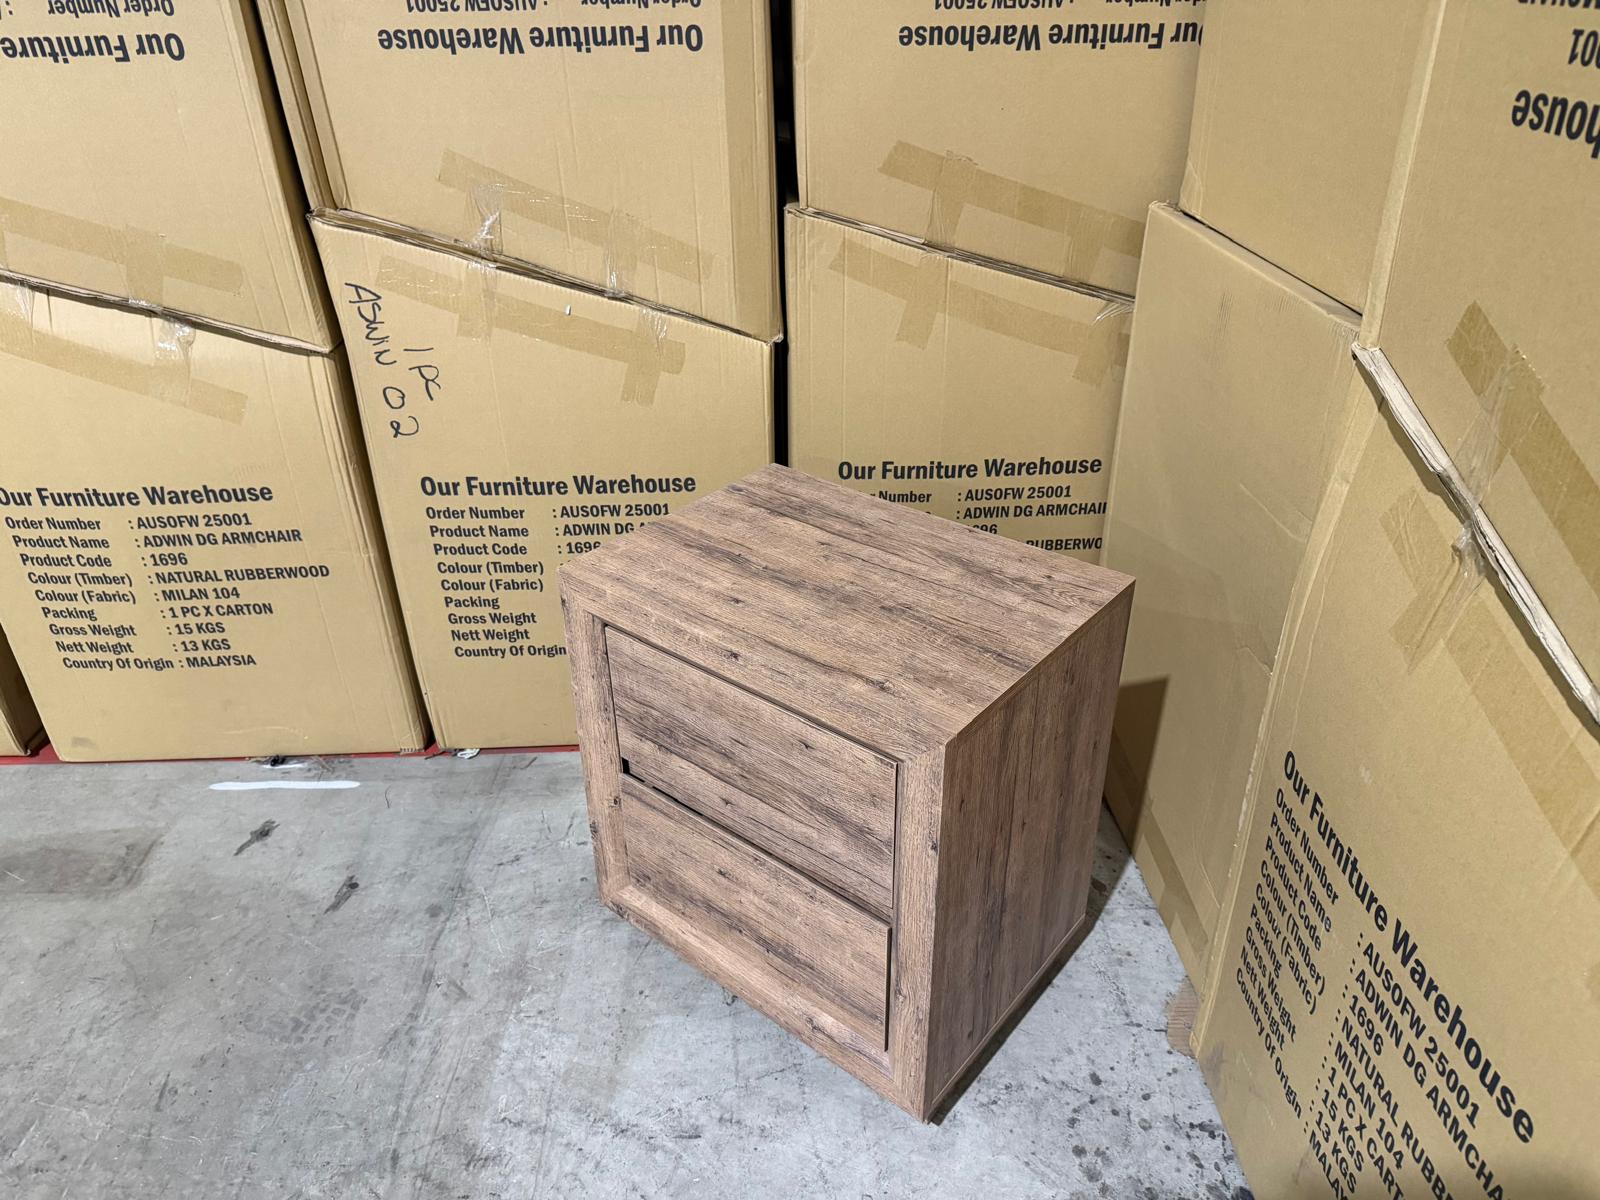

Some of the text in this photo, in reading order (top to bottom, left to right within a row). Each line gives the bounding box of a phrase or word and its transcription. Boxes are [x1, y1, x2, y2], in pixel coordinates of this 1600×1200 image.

[48, 0, 120, 18] Number
[124, 0, 174, 16] Order
[378, 24, 703, 55] Our Furniture Warehouse
[899, 22, 1203, 51] ur Furniture Warehouse
[0, 33, 185, 64] Our Furniture
[838, 457, 1102, 480] Our Furniture Warehouse
[420, 474, 696, 496] Our Furniture Warehouse
[878, 490, 932, 503] Number
[965, 487, 1024, 501] AUSOFW
[1027, 485, 1071, 499] 25001
[35, 487, 140, 507] Furniture
[142, 484, 273, 506] Warehouse
[425, 506, 466, 519] Order
[468, 506, 525, 519] Number
[560, 504, 621, 518] AUSOFW
[624, 503, 670, 517] 25001
[963, 506, 1009, 519] ADWIN
[1014, 505, 1033, 517] DG
[5, 516, 43, 530] Order
[45, 517, 101, 530] Number
[137, 515, 199, 530] AUSOFW
[202, 513, 252, 527] 25001
[429, 525, 486, 538] Product
[488, 525, 529, 537] Name
[563, 523, 611, 536] ADWIN
[12, 535, 68, 548] Product
[68, 536, 110, 549] Name
[144, 534, 194, 548] ADWIN
[195, 533, 219, 546] DG
[222, 529, 303, 545] ARMCHAIR
[433, 543, 489, 555] Product
[491, 543, 527, 555] Code
[19, 553, 75, 567] Product
[76, 554, 112, 567] Code
[150, 552, 188, 566] 1696
[437, 561, 483, 574] Colour
[486, 561, 544, 576] (Timber)
[27, 572, 72, 585] Colour
[74, 572, 133, 588] (Timber)
[155, 570, 223, 584] NATURAL
[224, 565, 330, 582] RUBBERWOOD
[440, 578, 544, 593] Colour (Fabric)
[34, 589, 78, 602] Colour
[81, 590, 136, 605] (Fabric)
[161, 588, 209, 601] MILAN
[212, 587, 240, 599] 104
[444, 596, 500, 610] Packing
[41, 606, 98, 622] Packing
[168, 607, 179, 618] 1
[180, 605, 201, 618] PC
[202, 605, 214, 617] X
[215, 603, 274, 616] CARTON
[448, 612, 537, 626] Gross Weight
[49, 623, 88, 636] Gross
[87, 624, 137, 638] Weight
[175, 623, 194, 635] 15
[195, 622, 226, 634] KGS
[451, 628, 530, 643] Nett Weight
[55, 641, 86, 653] Nett
[85, 641, 134, 655] Weight
[180, 640, 199, 652] 13
[201, 638, 231, 651] KGS
[454, 644, 567, 659] Country Of Origin
[62, 657, 113, 671] Country
[115, 658, 131, 669] Of
[133, 658, 174, 671] Origin
[185, 654, 257, 668] MALAYSIA
[1265, 835, 1298, 907] Product
[1298, 899, 1321, 952] Code
[1349, 995, 1384, 1056] 1696
[1270, 811, 1304, 883] Product
[1303, 872, 1332, 933] Name
[1355, 969, 1403, 1049] ADWIN
[1402, 1042, 1427, 1088] DG
[1284, 750, 1534, 1143] Our Furniture Warehouse
[1276, 788, 1301, 838] Order
[1300, 830, 1339, 905] Number
[1362, 942, 1427, 1040] AUSOFW
[1424, 1036, 1479, 1129] 25001
[1250, 903, 1282, 979] Packing
[1328, 1066, 1337, 1088] 1
[1337, 1082, 1356, 1119] PC
[1354, 1114, 1367, 1141] X
[1256, 883, 1282, 940] Colour
[1280, 936, 1317, 1015] (Fabric)
[1334, 1040, 1376, 1120] MILAN
[1376, 1117, 1404, 1170] 104
[1261, 860, 1287, 917] Colour
[1286, 913, 1325, 996] (Timber)
[1341, 1016, 1399, 1128] NATURAL
[1400, 1120, 1454, 1200] RUBB
[1236, 968, 1265, 1037] Country
[1265, 1032, 1276, 1059] Of
[1275, 1056, 1302, 1119] Origin
[1246, 926, 1267, 978] Gross
[1267, 971, 1296, 1043] Weight
[1321, 1089, 1338, 1122] 15
[1338, 1118, 1364, 1172] KGS
[1240, 945, 1257, 989] Nett
[1257, 981, 1285, 1051] Weight
[1315, 1110, 1331, 1143] 13
[1331, 1140, 1357, 1194] KGS
